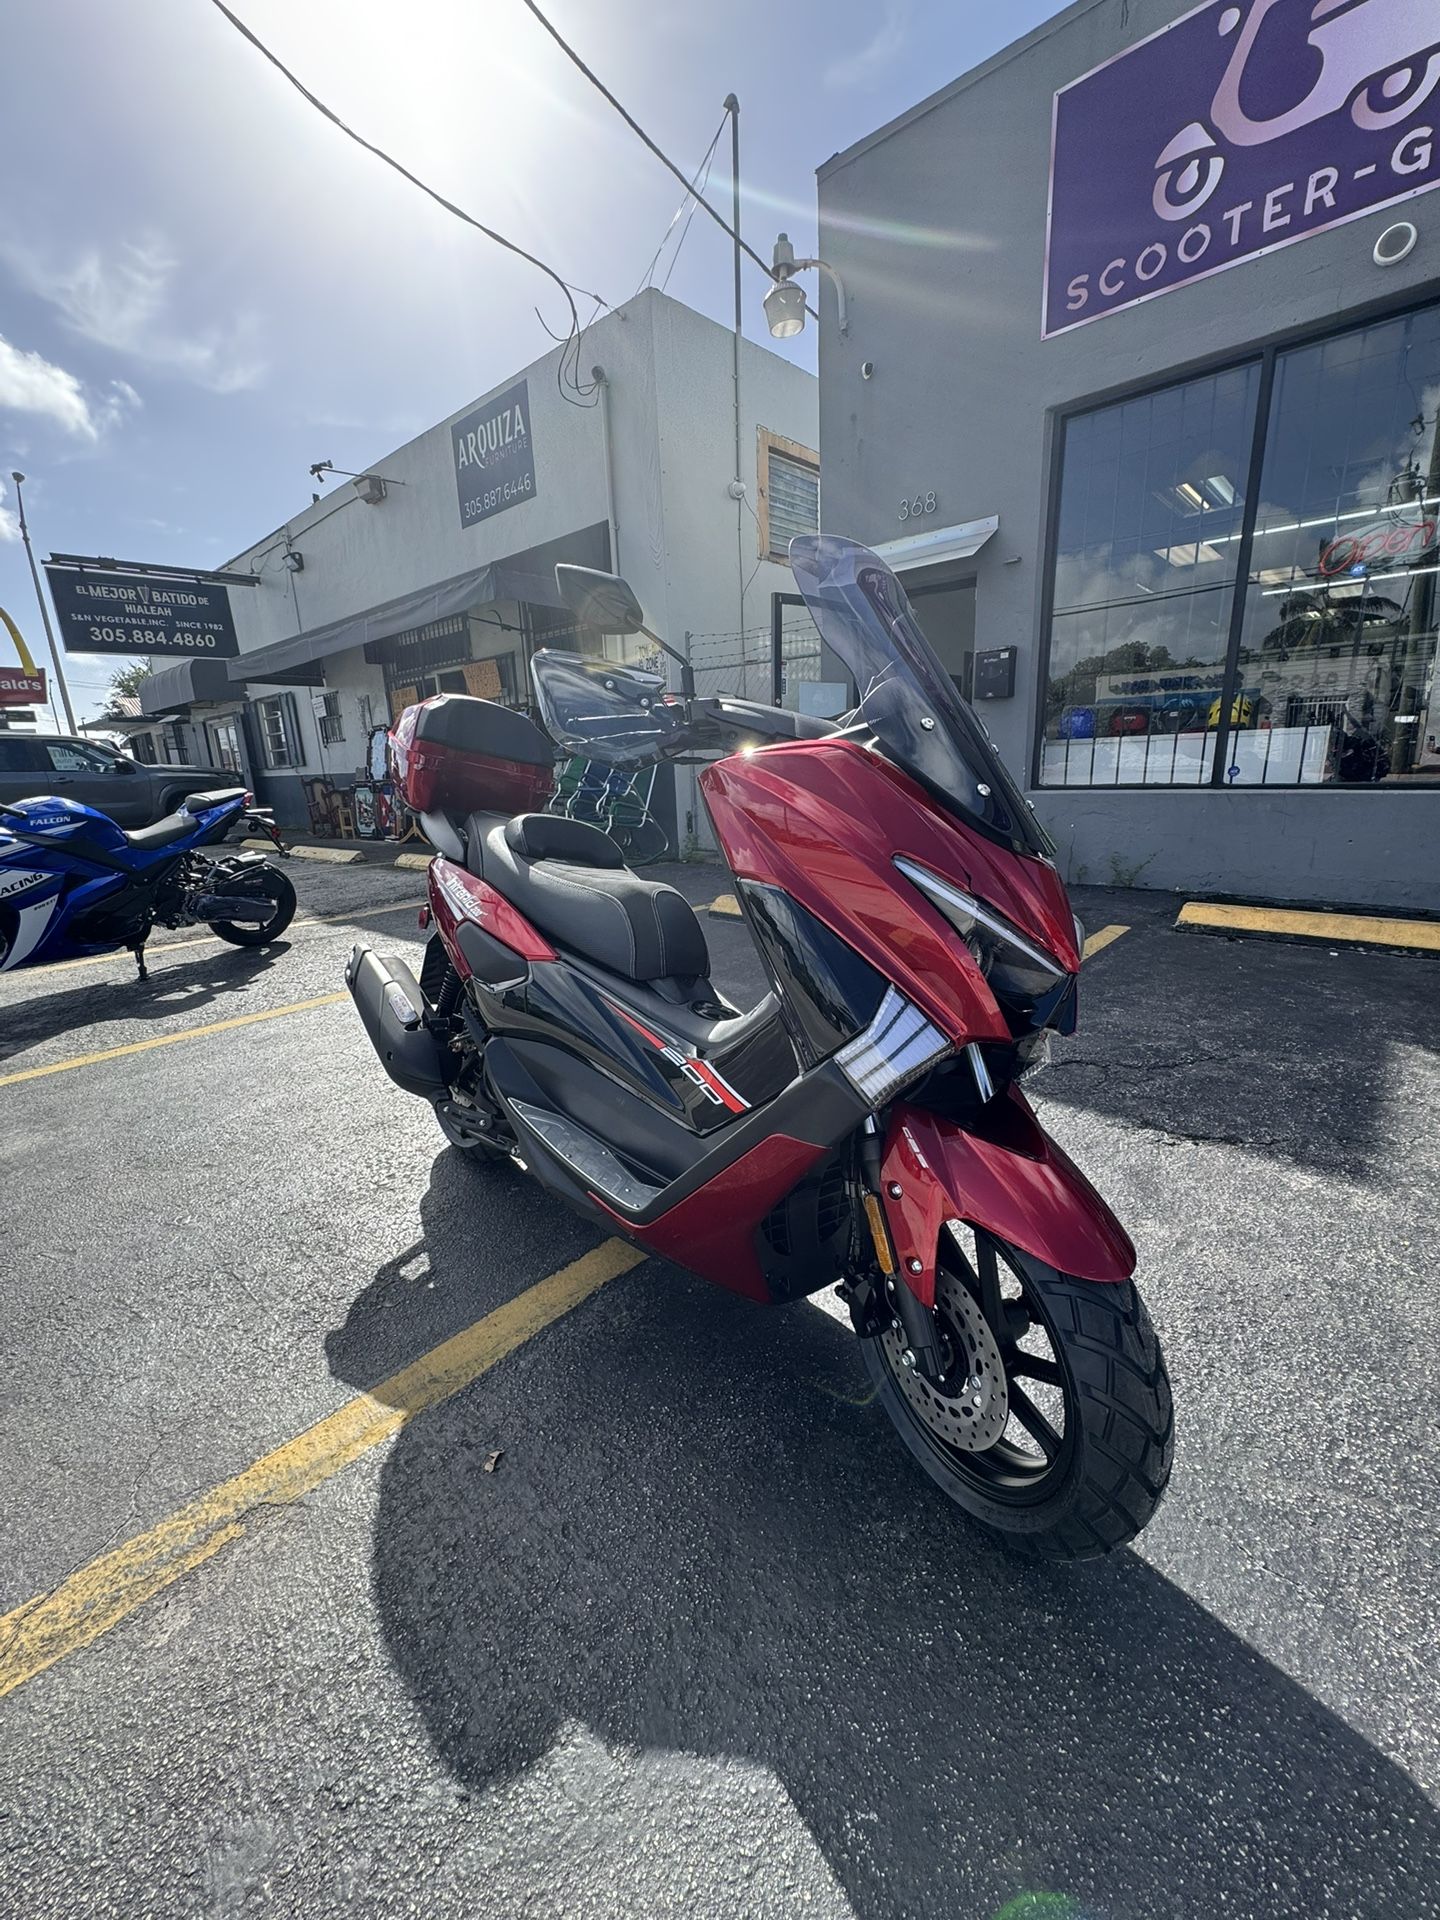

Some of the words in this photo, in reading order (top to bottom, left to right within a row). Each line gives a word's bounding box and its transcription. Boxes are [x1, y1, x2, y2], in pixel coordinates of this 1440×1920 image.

[458, 404, 526, 469] ARQUIZA
[485, 437, 529, 467] FURNITURE
[464, 473, 532, 519] 305.887.6446
[898, 491, 936, 521] 368
[1319, 521, 1435, 577] Open
[76, 586, 88, 595] EL
[88, 585, 137, 601] MEJOR
[152, 591, 197, 606] BATIDO
[198, 597, 209, 606] DE
[125, 603, 172, 617] HIALEAH
[71, 613, 92, 622] S&N
[176, 620, 201, 629] SINCE
[204, 623, 224, 631] 1982
[90, 627, 216, 648] 305.884.4860
[30, 816, 71, 826] FALCON
[660, 1046, 725, 1106] 200
